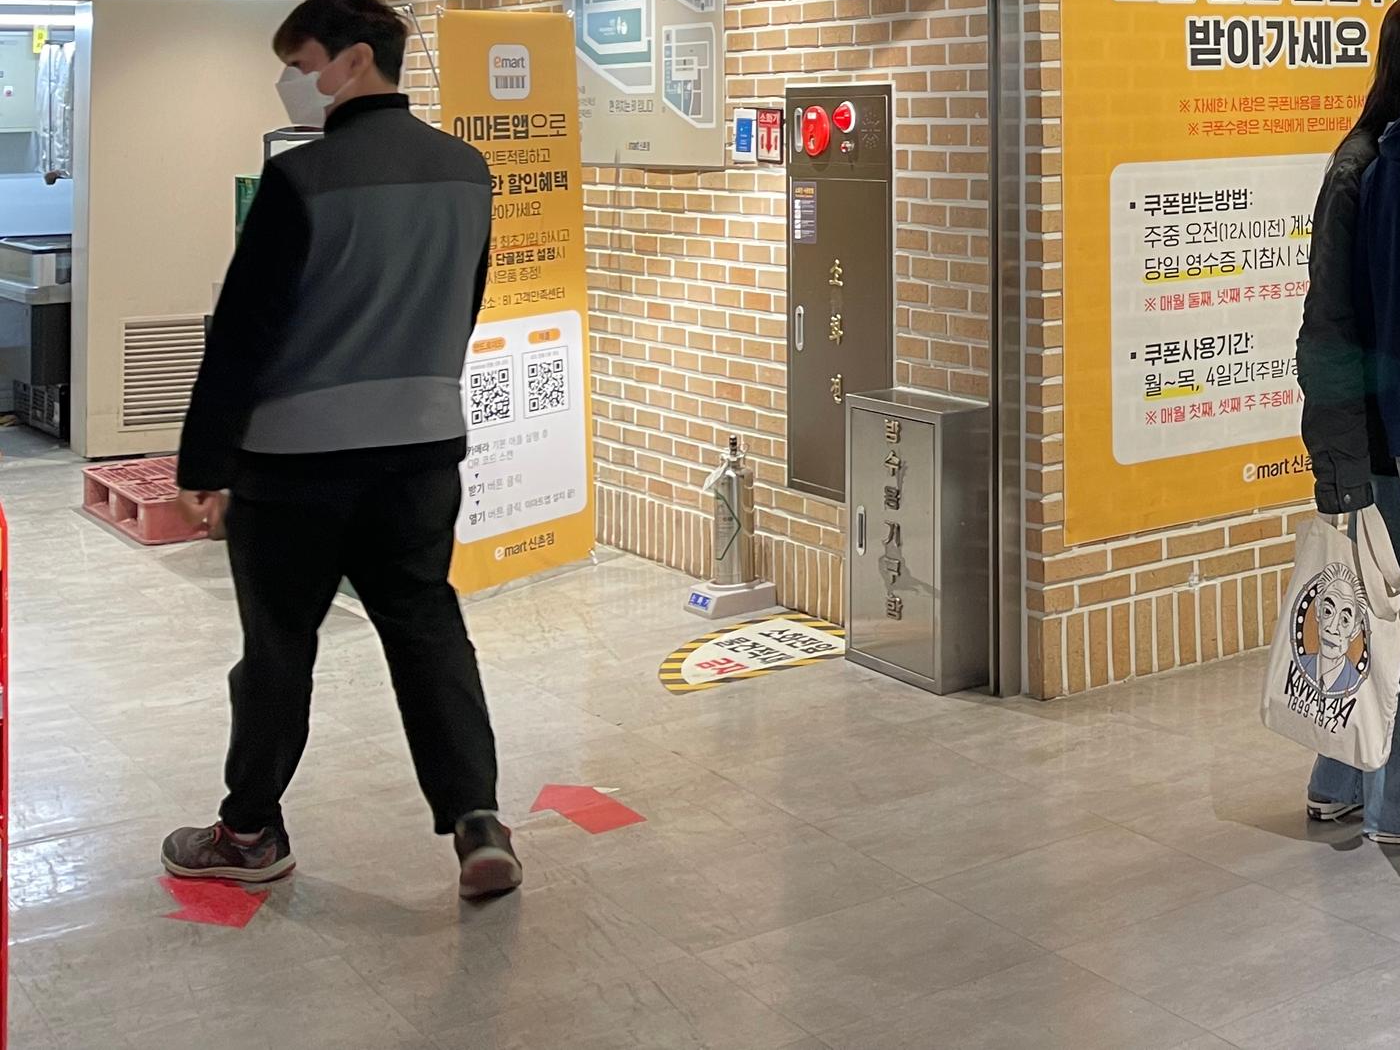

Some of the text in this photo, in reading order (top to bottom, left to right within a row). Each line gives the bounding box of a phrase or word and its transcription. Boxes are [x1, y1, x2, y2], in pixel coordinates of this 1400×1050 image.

[1188, 19, 1368, 67] 받아가세요
[494, 56, 526, 69] emart
[1194, 98, 1227, 113] 자세한
[1231, 96, 1265, 112] 사항은
[1268, 95, 1321, 111] 쿠폰내용을
[1324, 95, 1344, 109] 참조
[454, 113, 567, 142] 이마트앱으로
[1201, 120, 1260, 136] 쿠폰수령은
[1263, 118, 1304, 134] 직원에게
[481, 148, 551, 167] 인트적립하고
[507, 170, 568, 195] 할인혜택
[1144, 189, 1253, 216] 쿠폰받는방법:
[500, 232, 538, 249] 최초가입
[541, 228, 570, 245] 하시고
[1144, 225, 1180, 248] 주중
[496, 249, 534, 267] 단골점포
[1145, 256, 1179, 281] 당일
[1186, 251, 1236, 277] 영수증
[1242, 246, 1290, 270] 지참시
[1160, 294, 1184, 311] 매월
[1217, 287, 1241, 305] 넷째
[1244, 286, 1255, 301] 주
[1259, 284, 1281, 300] 주중
[1144, 332, 1254, 366] 쿠폰사용기간:
[1161, 407, 1186, 424] 매월
[1219, 397, 1241, 415] 셋째
[1244, 395, 1256, 411] 주
[1260, 389, 1294, 408] 주중에
[1242, 458, 1289, 483] emart
[494, 531, 555, 562] emart 신촌점
[694, 657, 750, 676] 금지
[1287, 694, 1339, 734] 1899-1972
